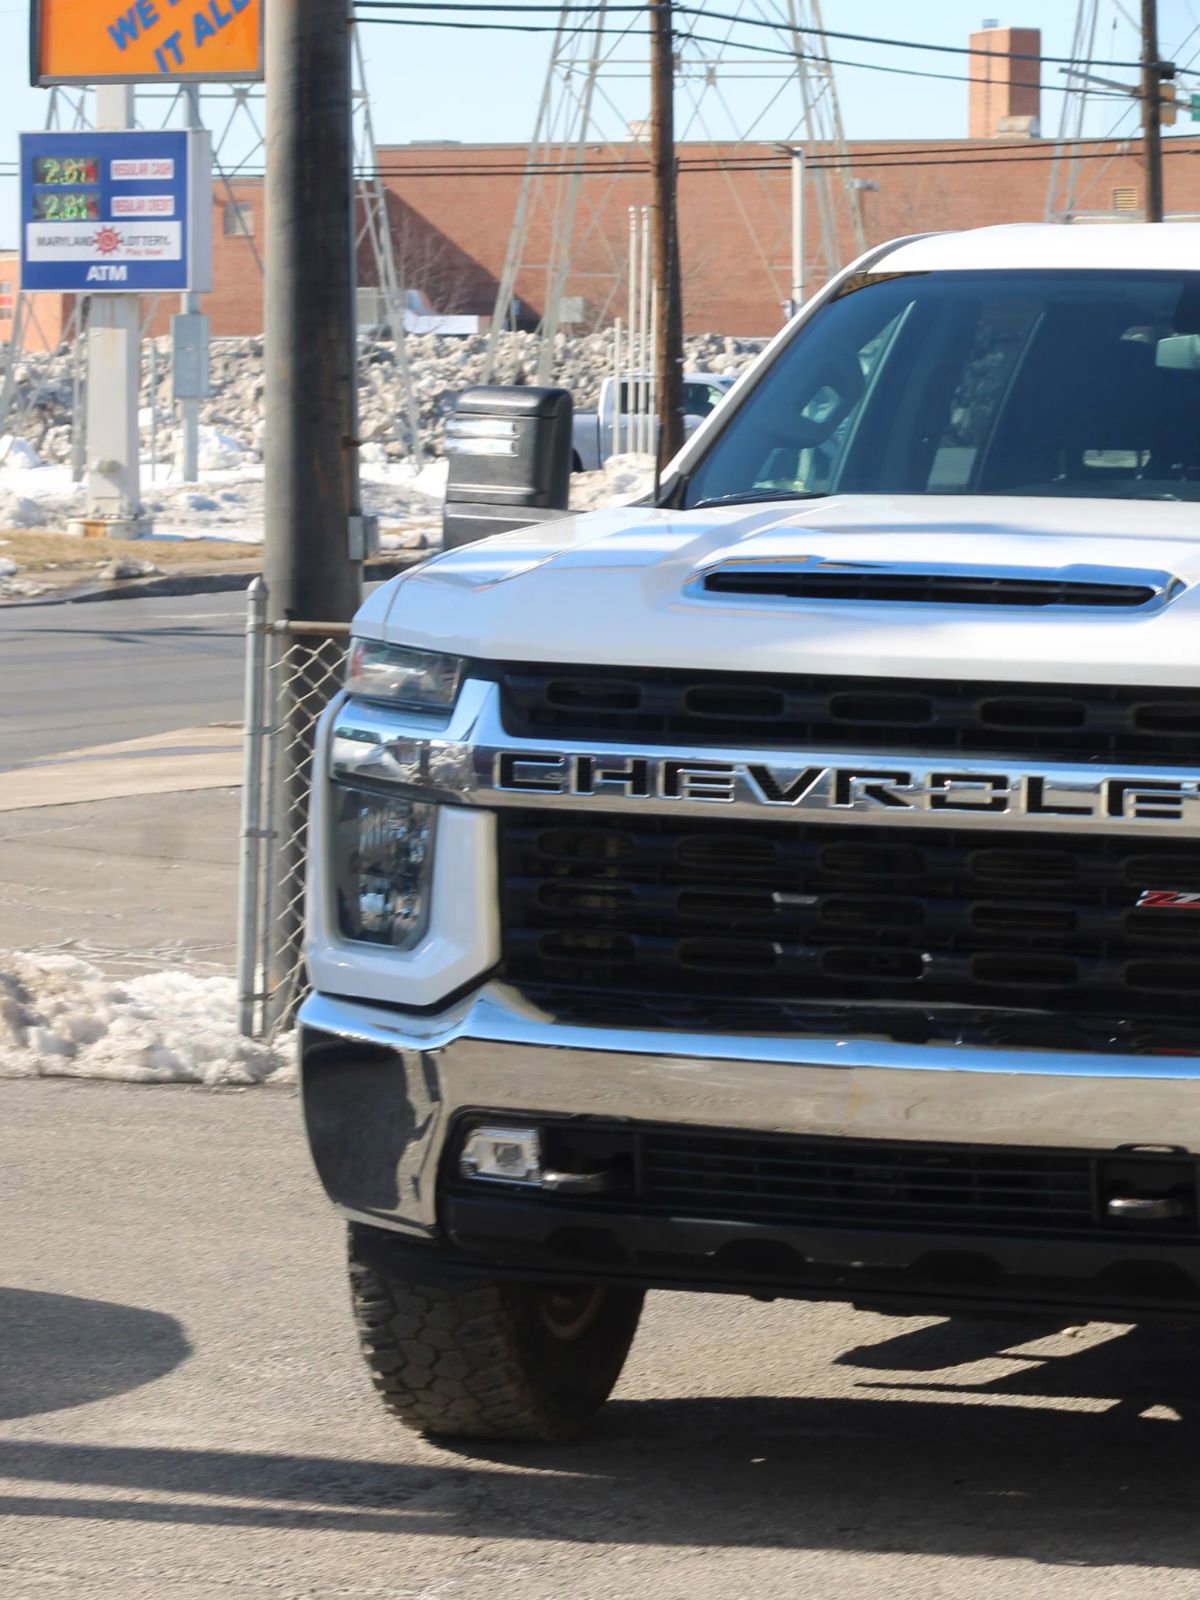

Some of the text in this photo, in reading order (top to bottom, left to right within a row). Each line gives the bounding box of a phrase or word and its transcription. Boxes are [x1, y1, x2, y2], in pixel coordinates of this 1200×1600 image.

[107, 0, 160, 51] WE
[153, 30, 184, 72] IT
[36, 235, 169, 247] MARYLAND LOTTERY
[86, 265, 128, 281] ATM
